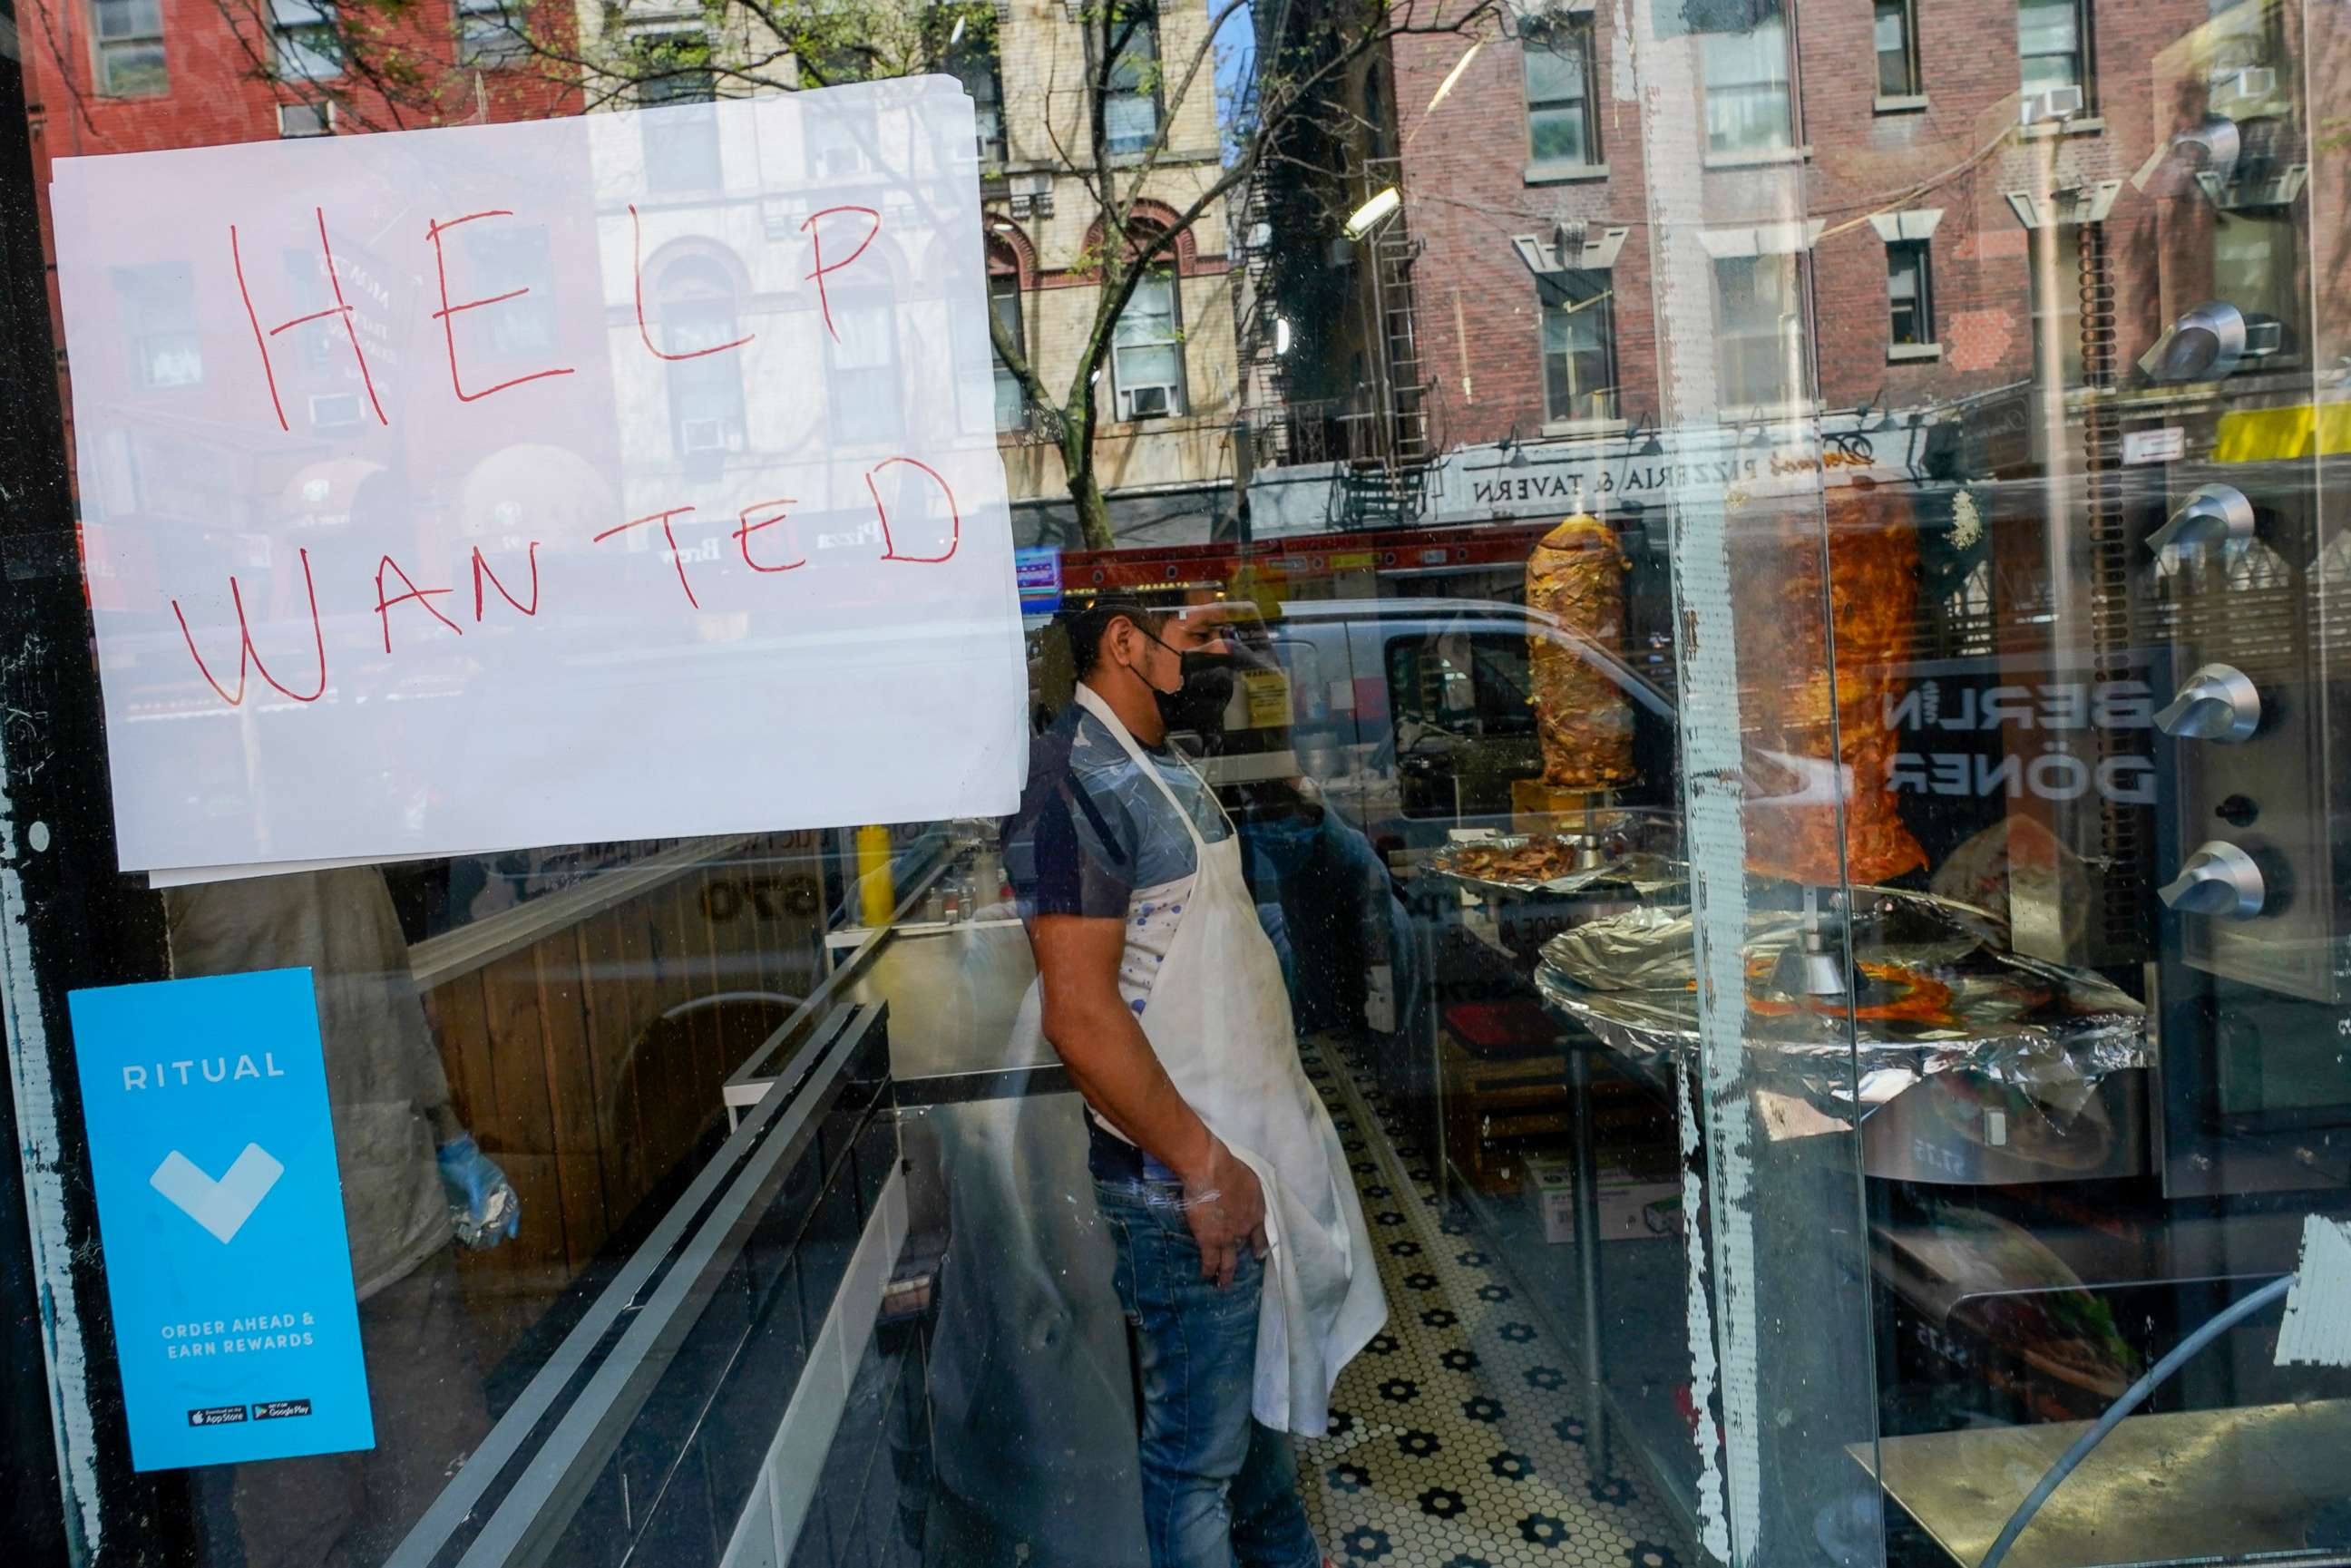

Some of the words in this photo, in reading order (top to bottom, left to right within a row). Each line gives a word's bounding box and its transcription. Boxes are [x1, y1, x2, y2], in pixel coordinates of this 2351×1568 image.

[231, 207, 878, 433] HELP
[171, 457, 959, 706] WANTED
[122, 1052, 285, 1091] RITUAL
[161, 1320, 225, 1339] ORDER
[232, 1313, 296, 1333] AHEAD
[302, 1311, 315, 1326] &
[168, 1342, 217, 1359] EARN
[223, 1332, 314, 1353] REWARDS
[206, 1414, 222, 1424] App
[222, 1412, 244, 1422] Store
